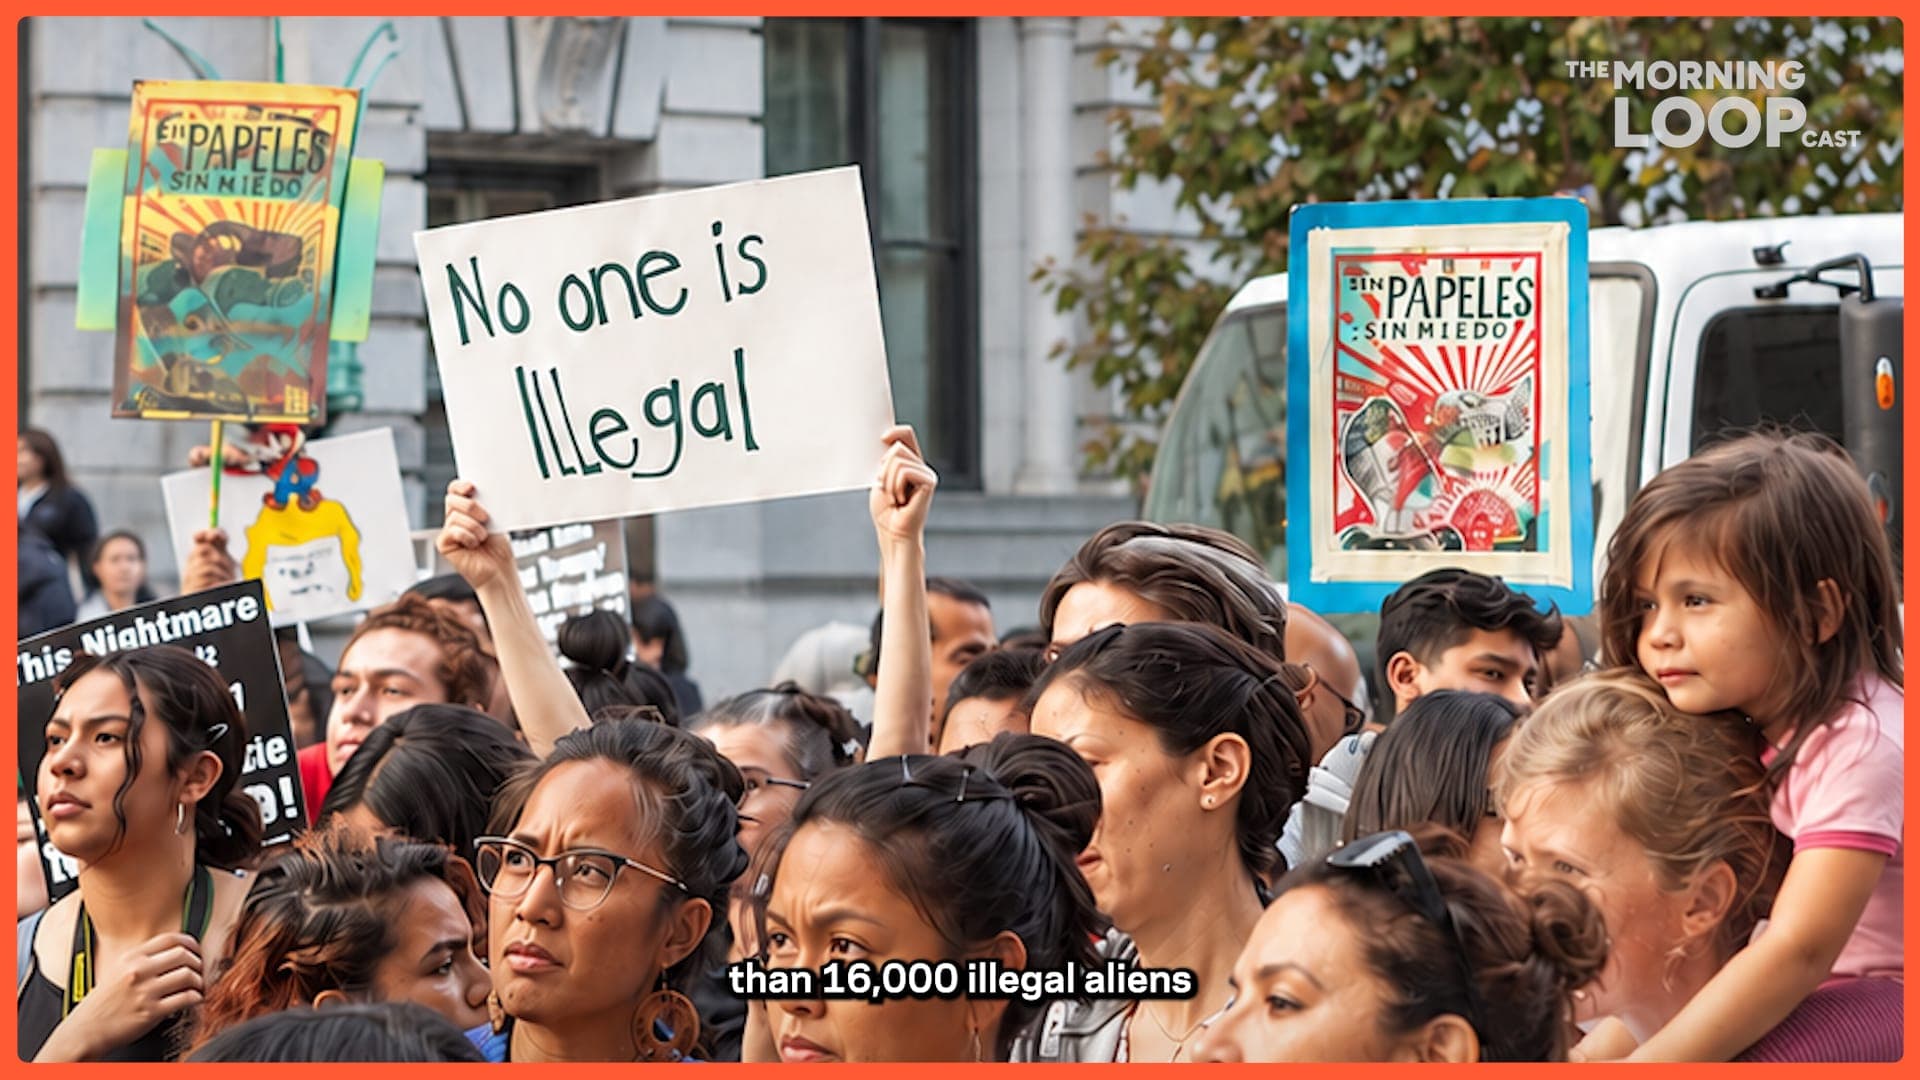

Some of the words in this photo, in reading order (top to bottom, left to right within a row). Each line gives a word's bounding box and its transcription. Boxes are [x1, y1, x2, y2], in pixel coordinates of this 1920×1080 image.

[185, 123, 331, 175] PAPELES
[169, 171, 209, 191] SIN
[445, 256, 531, 346] No
[558, 250, 689, 333] one
[711, 220, 769, 303] is
[1386, 275, 1535, 319] PAPELES
[1365, 321, 1407, 340] SIN
[1417, 322, 1508, 340] MIEDO
[515, 347, 761, 480] Illegal
[17, 645, 73, 687] his
